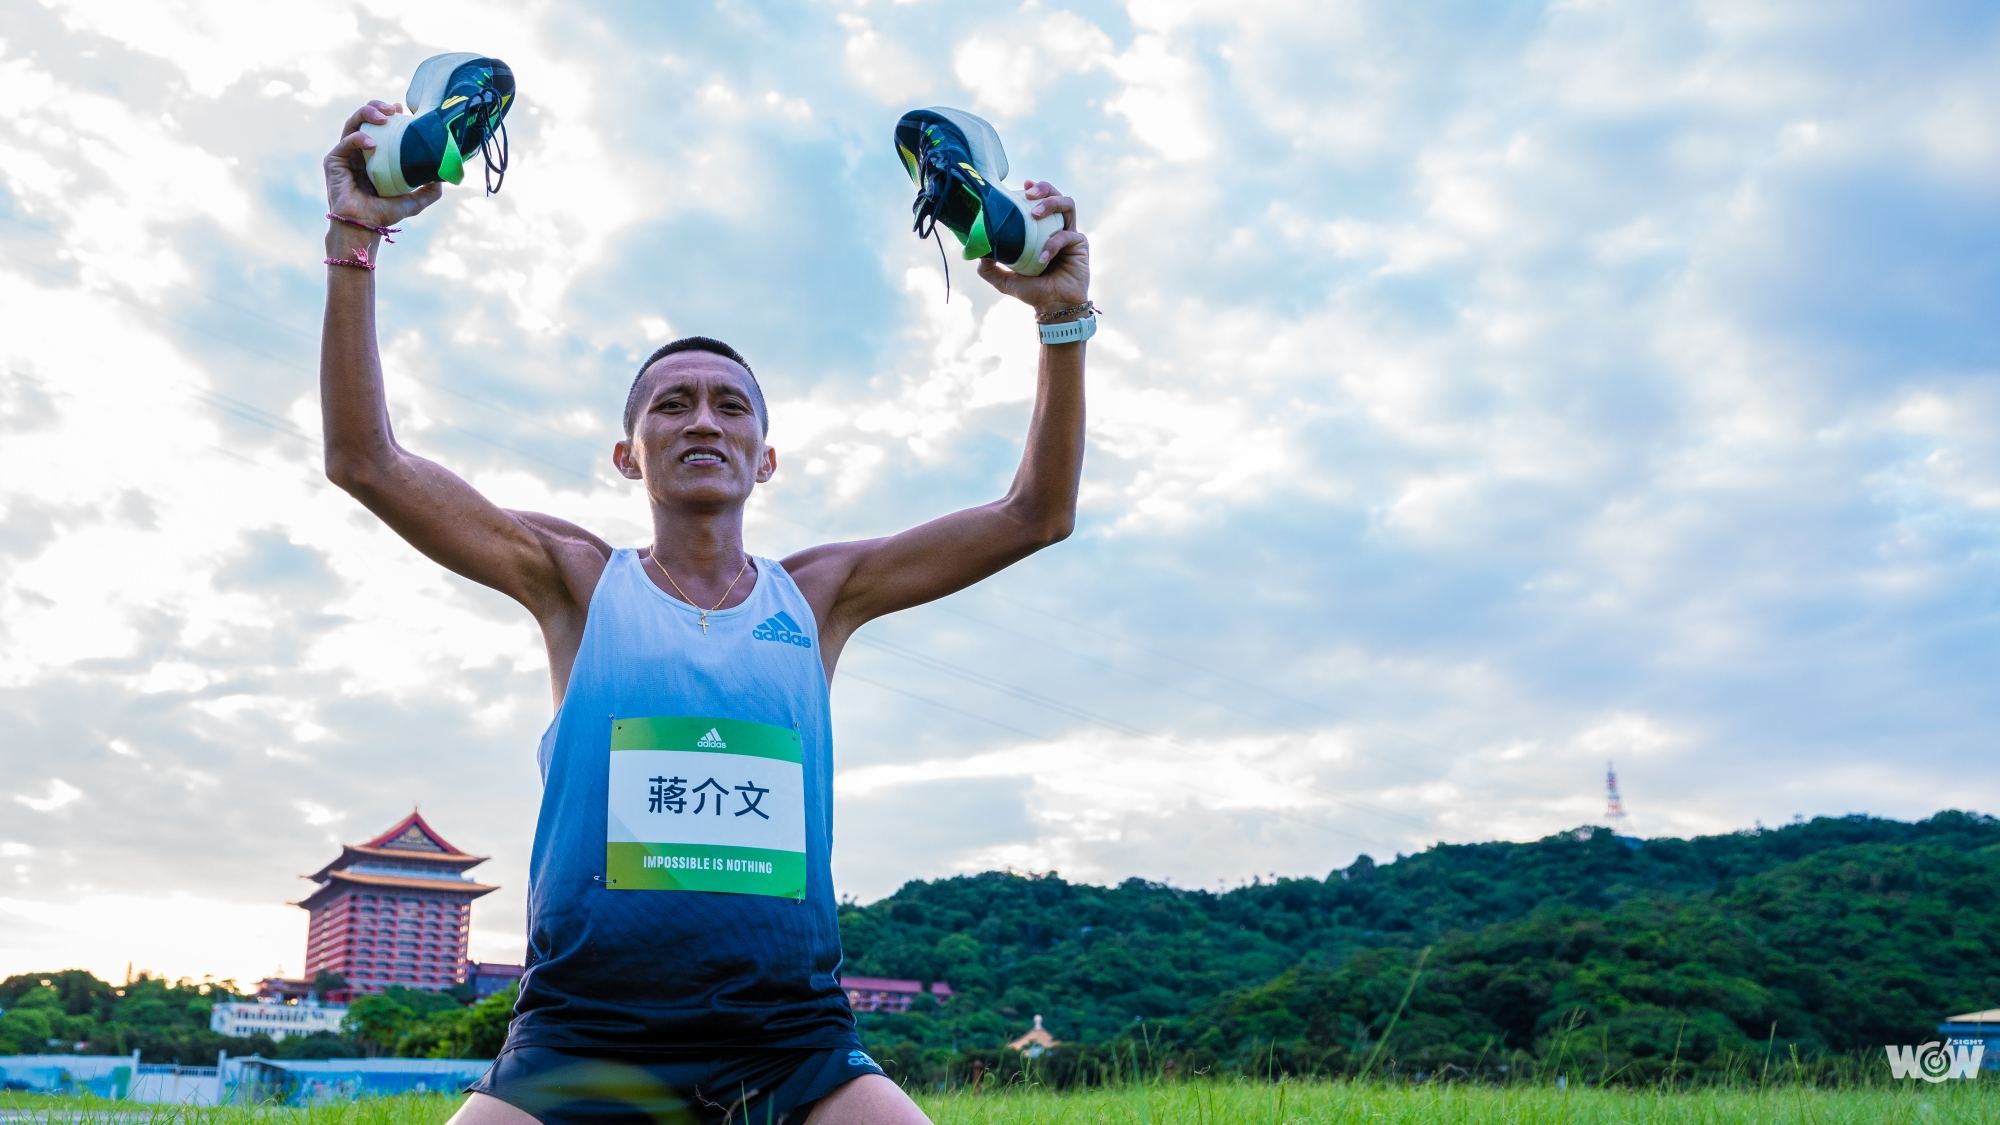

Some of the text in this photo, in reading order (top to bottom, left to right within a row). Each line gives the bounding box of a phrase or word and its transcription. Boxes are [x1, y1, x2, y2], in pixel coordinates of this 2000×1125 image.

[752, 629, 812, 649] adidas
[697, 739, 727, 749] adidas
[648, 775, 770, 820] 蔣介文
[643, 855, 773, 874] IMPOSSIBLE IS NOTHING
